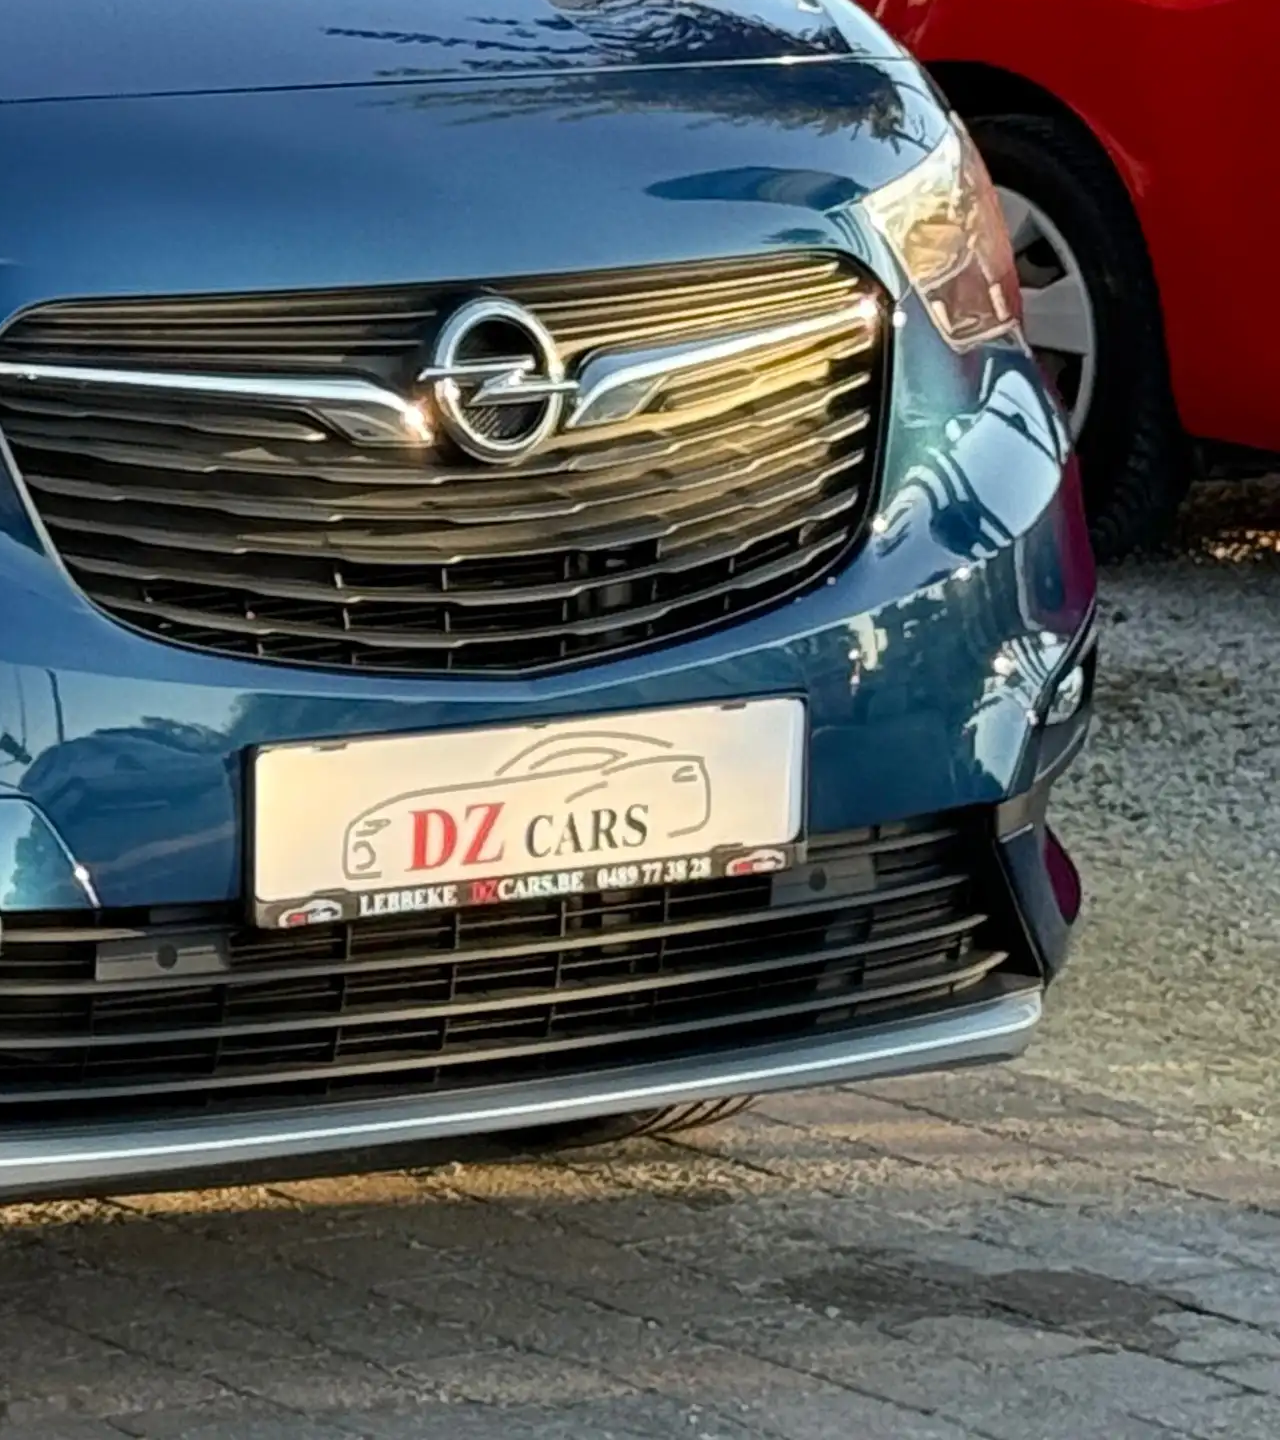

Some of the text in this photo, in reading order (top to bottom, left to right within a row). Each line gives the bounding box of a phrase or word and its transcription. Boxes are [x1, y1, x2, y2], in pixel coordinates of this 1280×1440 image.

[404, 802, 650, 872] DZ CARS
[470, 871, 585, 904] DZCARS.BE
[596, 865, 639, 890] 0489
[641, 860, 664, 885] 77
